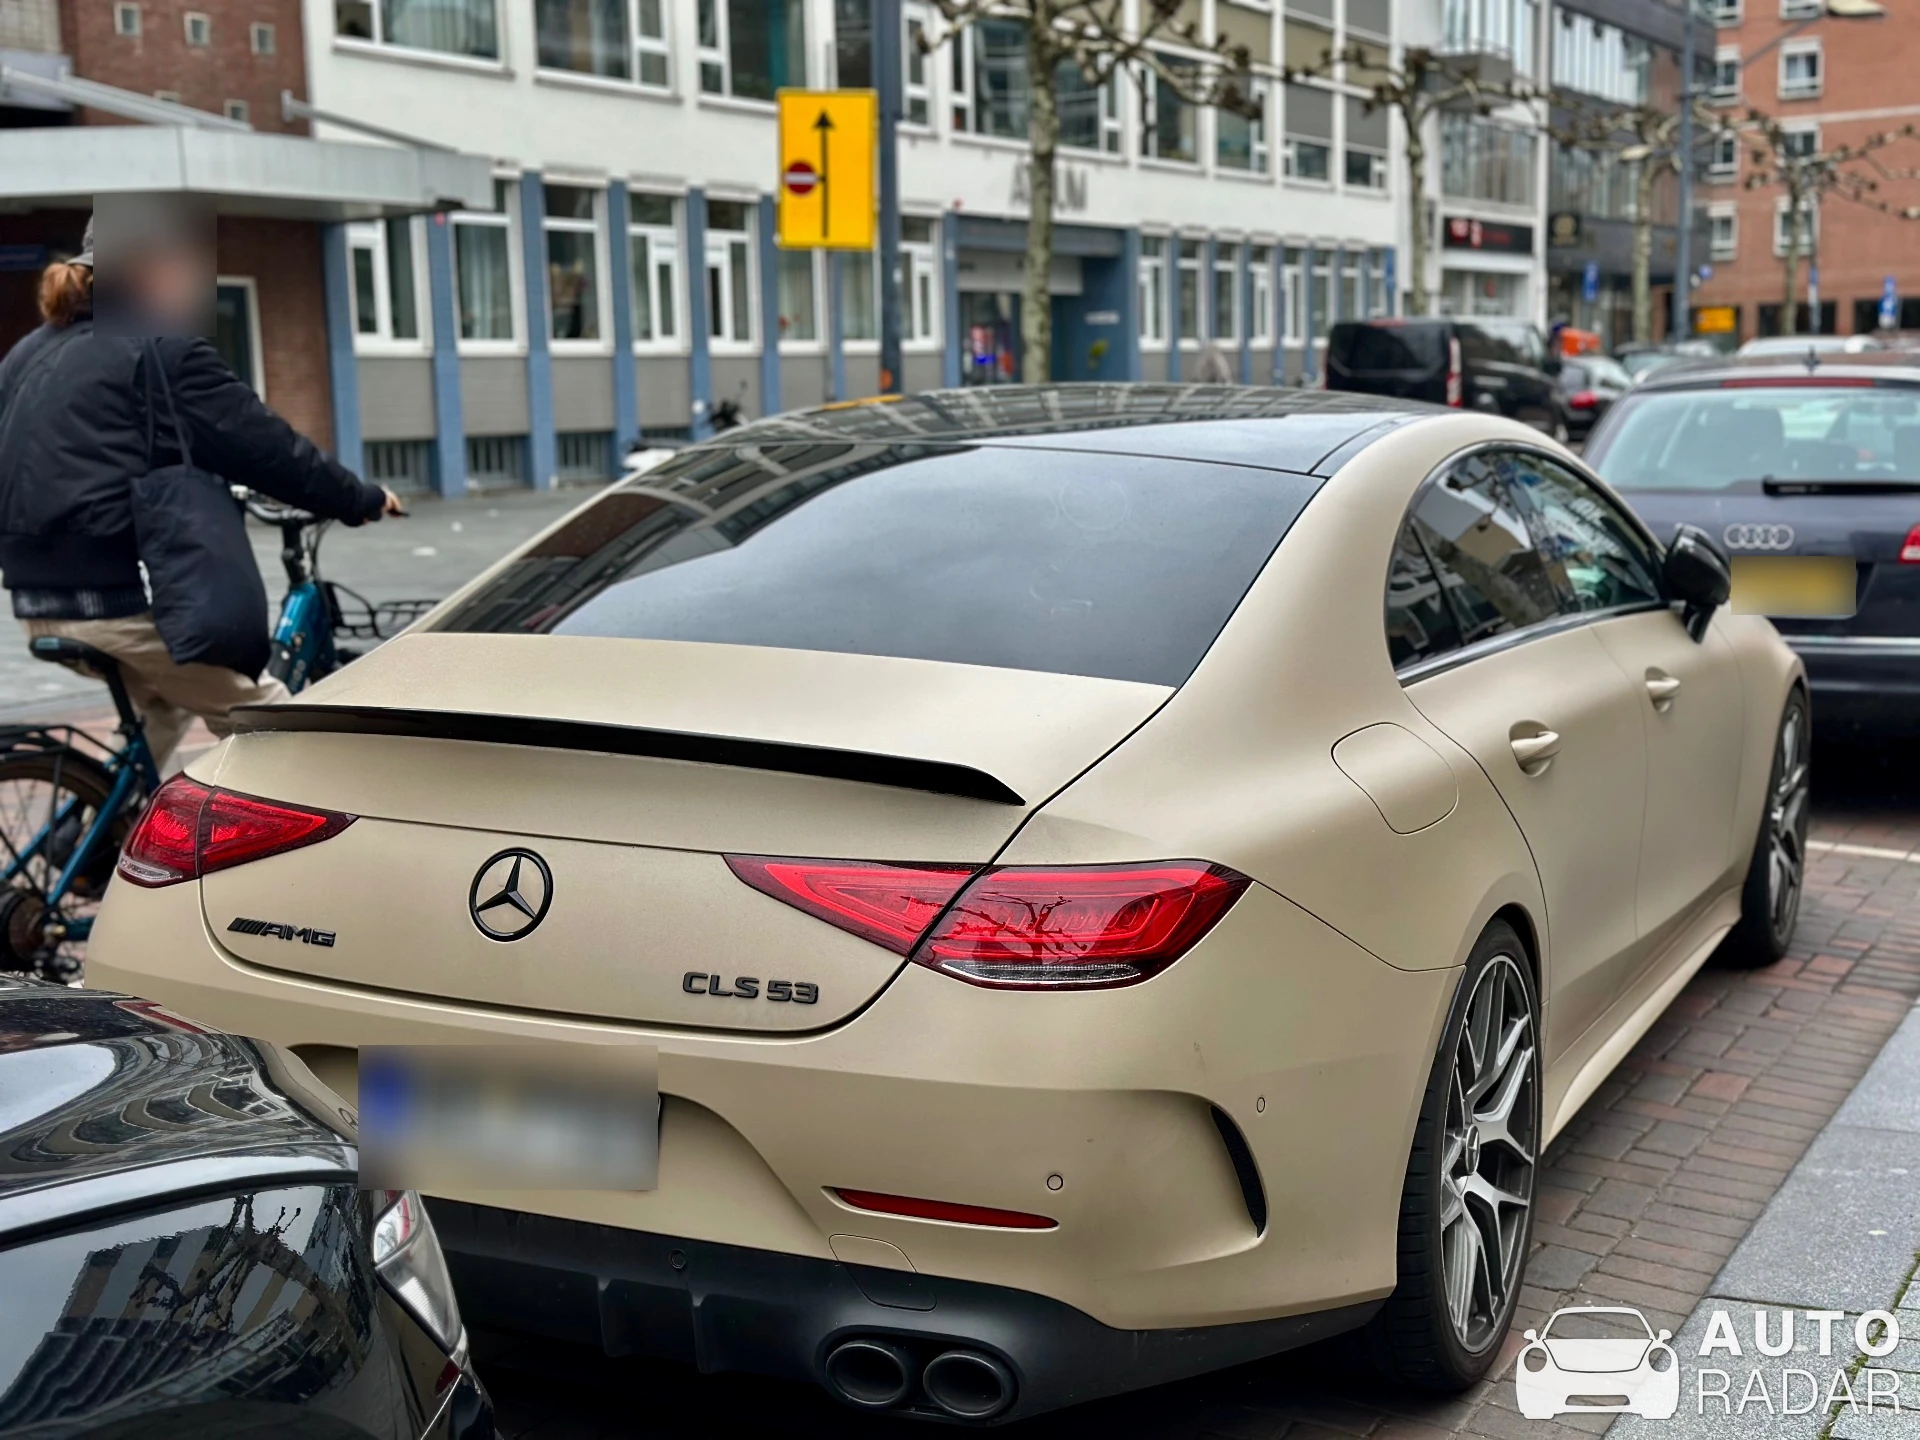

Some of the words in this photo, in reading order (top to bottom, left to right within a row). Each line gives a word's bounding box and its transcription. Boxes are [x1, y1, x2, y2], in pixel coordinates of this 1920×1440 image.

[259, 921, 336, 947] AMG
[683, 971, 760, 999] CLS
[766, 979, 819, 1004] 53
